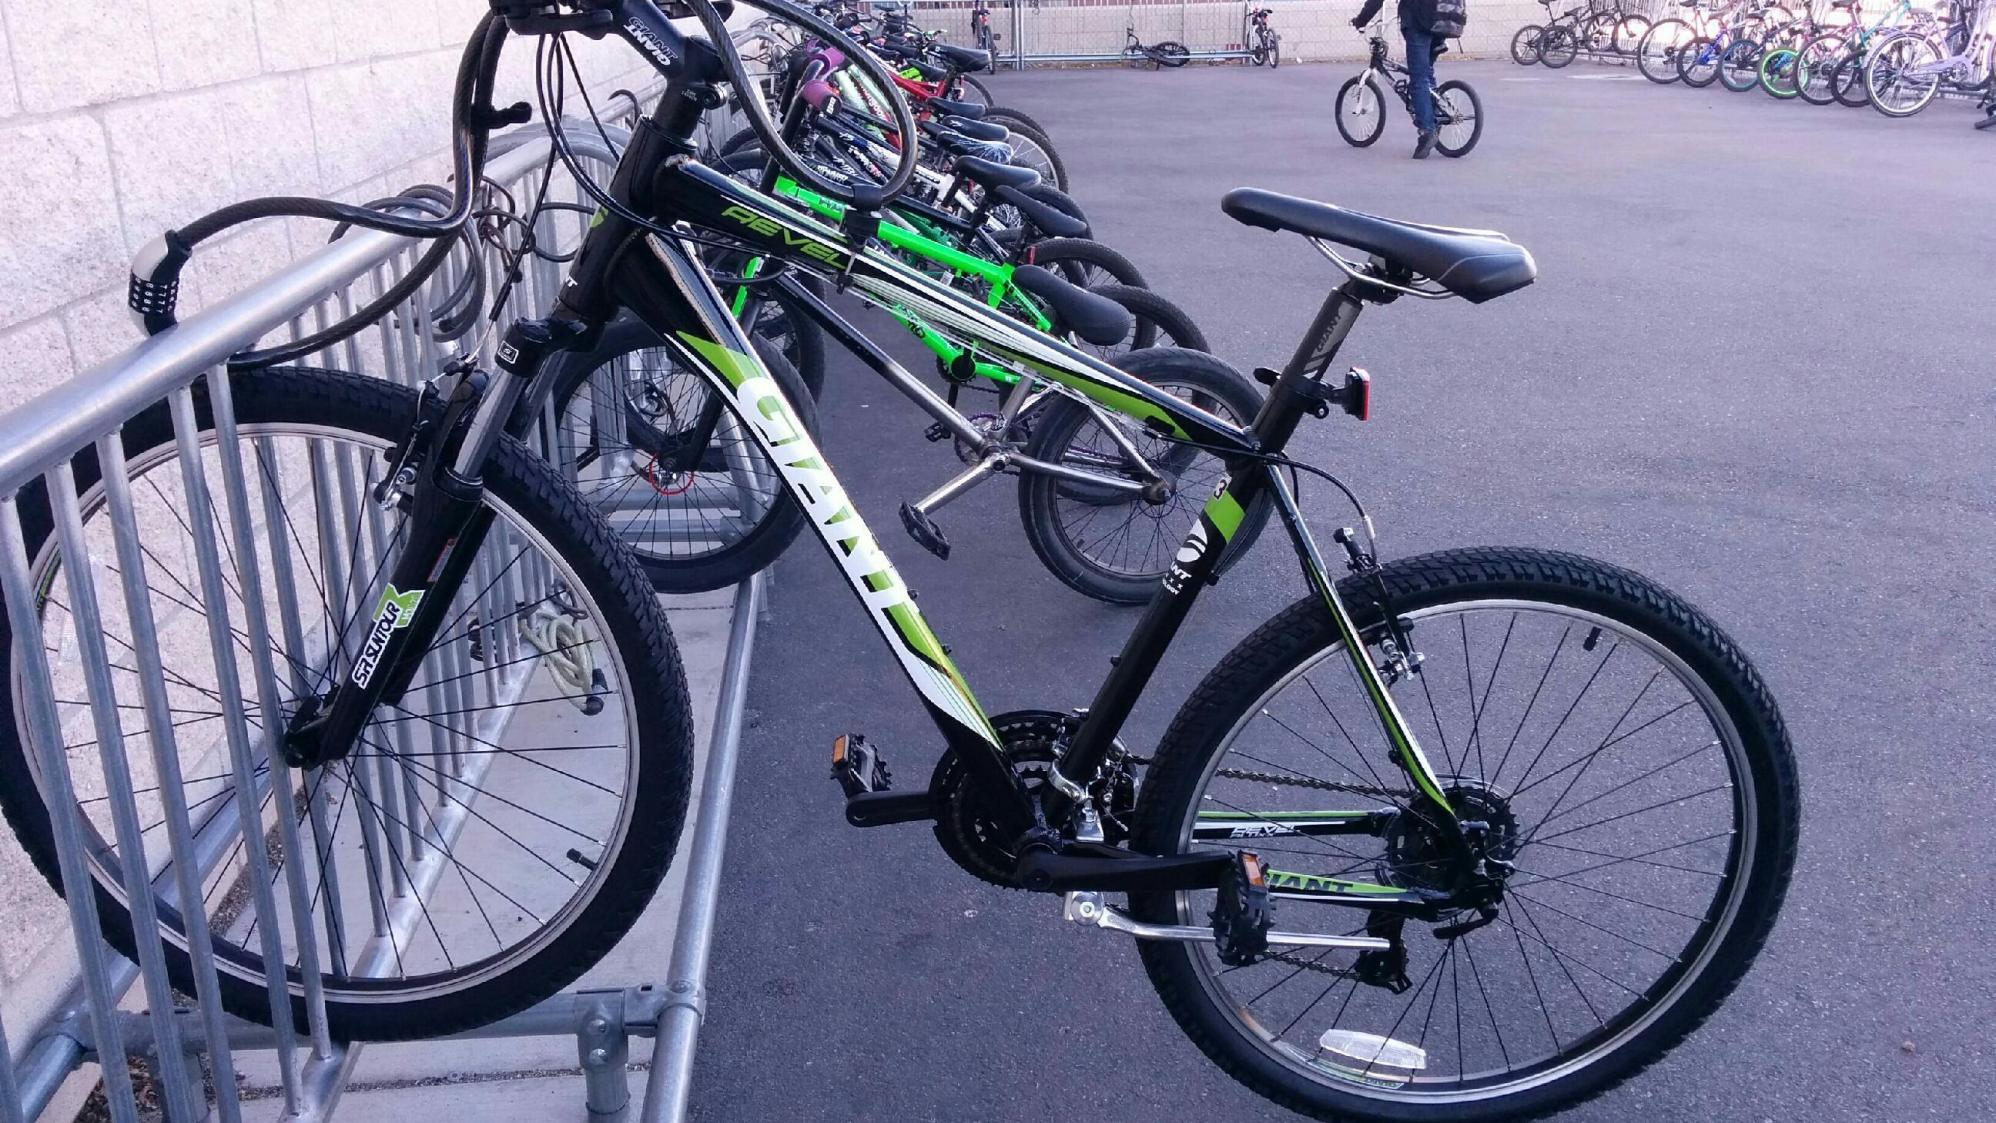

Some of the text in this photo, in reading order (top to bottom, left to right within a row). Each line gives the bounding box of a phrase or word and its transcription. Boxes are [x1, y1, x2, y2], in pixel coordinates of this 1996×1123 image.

[623, 24, 671, 66] GIANT
[628, 16, 679, 59] GIANT
[721, 205, 847, 270] REVEL
[737, 376, 920, 616] GIANT
[354, 602, 401, 690] SR SUNTOUR
[1268, 874, 1354, 893] IANT
